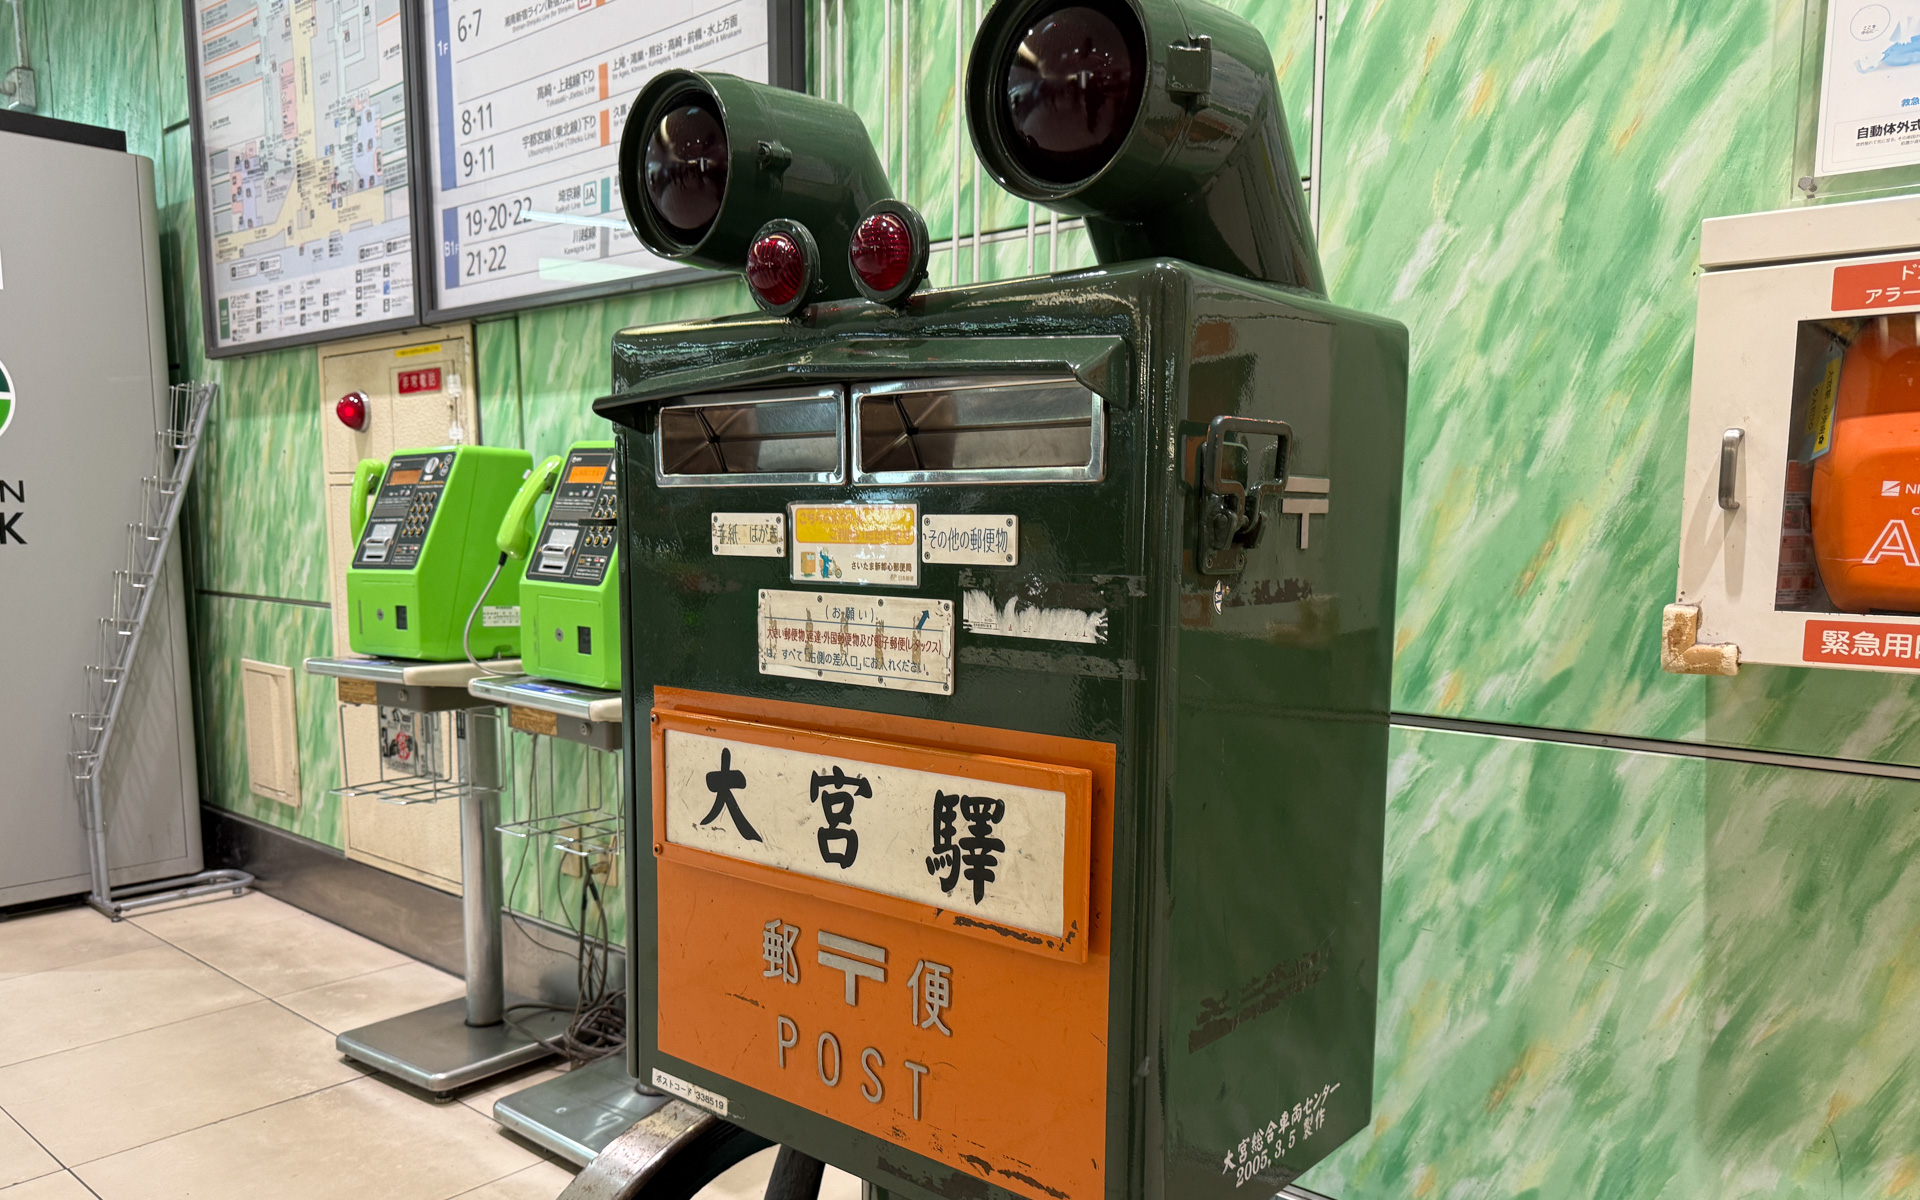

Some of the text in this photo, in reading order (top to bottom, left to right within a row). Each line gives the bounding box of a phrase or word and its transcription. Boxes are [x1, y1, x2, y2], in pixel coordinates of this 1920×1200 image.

[929, 527, 1008, 553] その他の郵便物
[851, 561, 912, 573] さいたま新都心郵便局
[1820, 629, 1920, 660] 緊急用
[700, 747, 1006, 905] 大宮驛
[777, 1014, 929, 1121] POST
[656, 1074, 724, 1110] ポストコード 338519
[1222, 1082, 1341, 1174] 大宮総合車両センター
